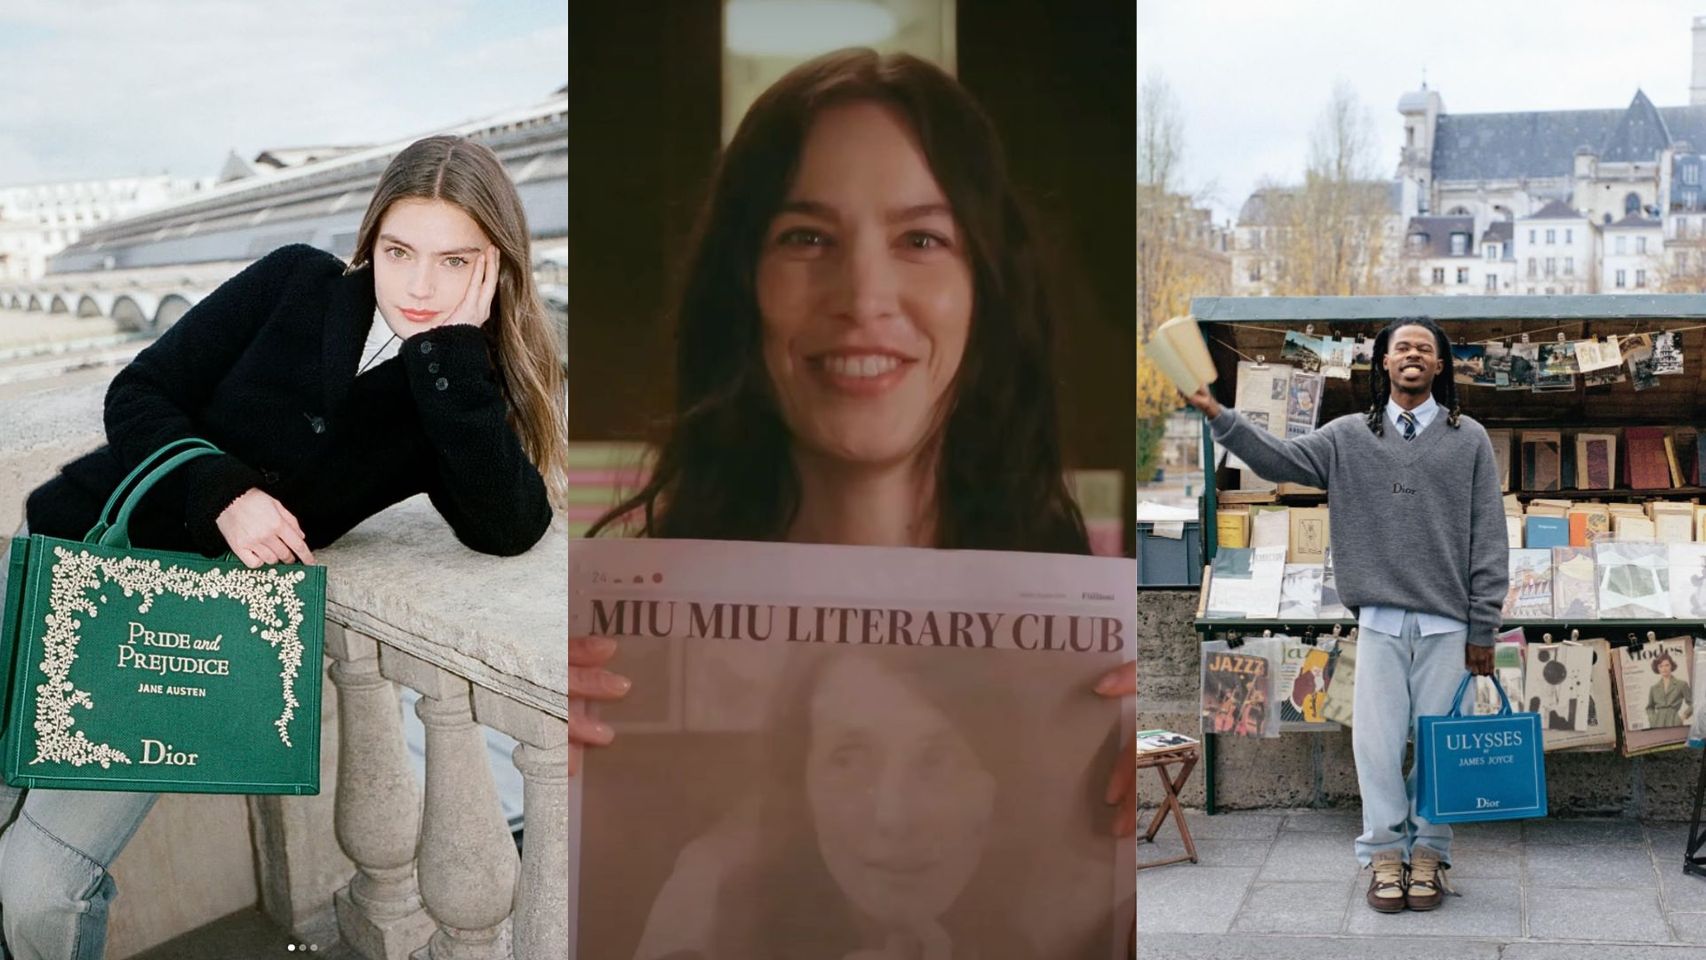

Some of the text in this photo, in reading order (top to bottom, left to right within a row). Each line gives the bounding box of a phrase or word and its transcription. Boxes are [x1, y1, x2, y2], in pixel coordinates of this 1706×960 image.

[1392, 482, 1416, 495] Dior
[589, 600, 1125, 653] MIU MIU LITERARY CLUB
[193, 633, 223, 651] and
[138, 683, 206, 697] JANE AUSTEN
[1446, 731, 1522, 750] ULYSSES
[139, 739, 198, 766] Dior
[1459, 755, 1514, 767] JAMES JOYCE
[1476, 798, 1500, 809] Dior
